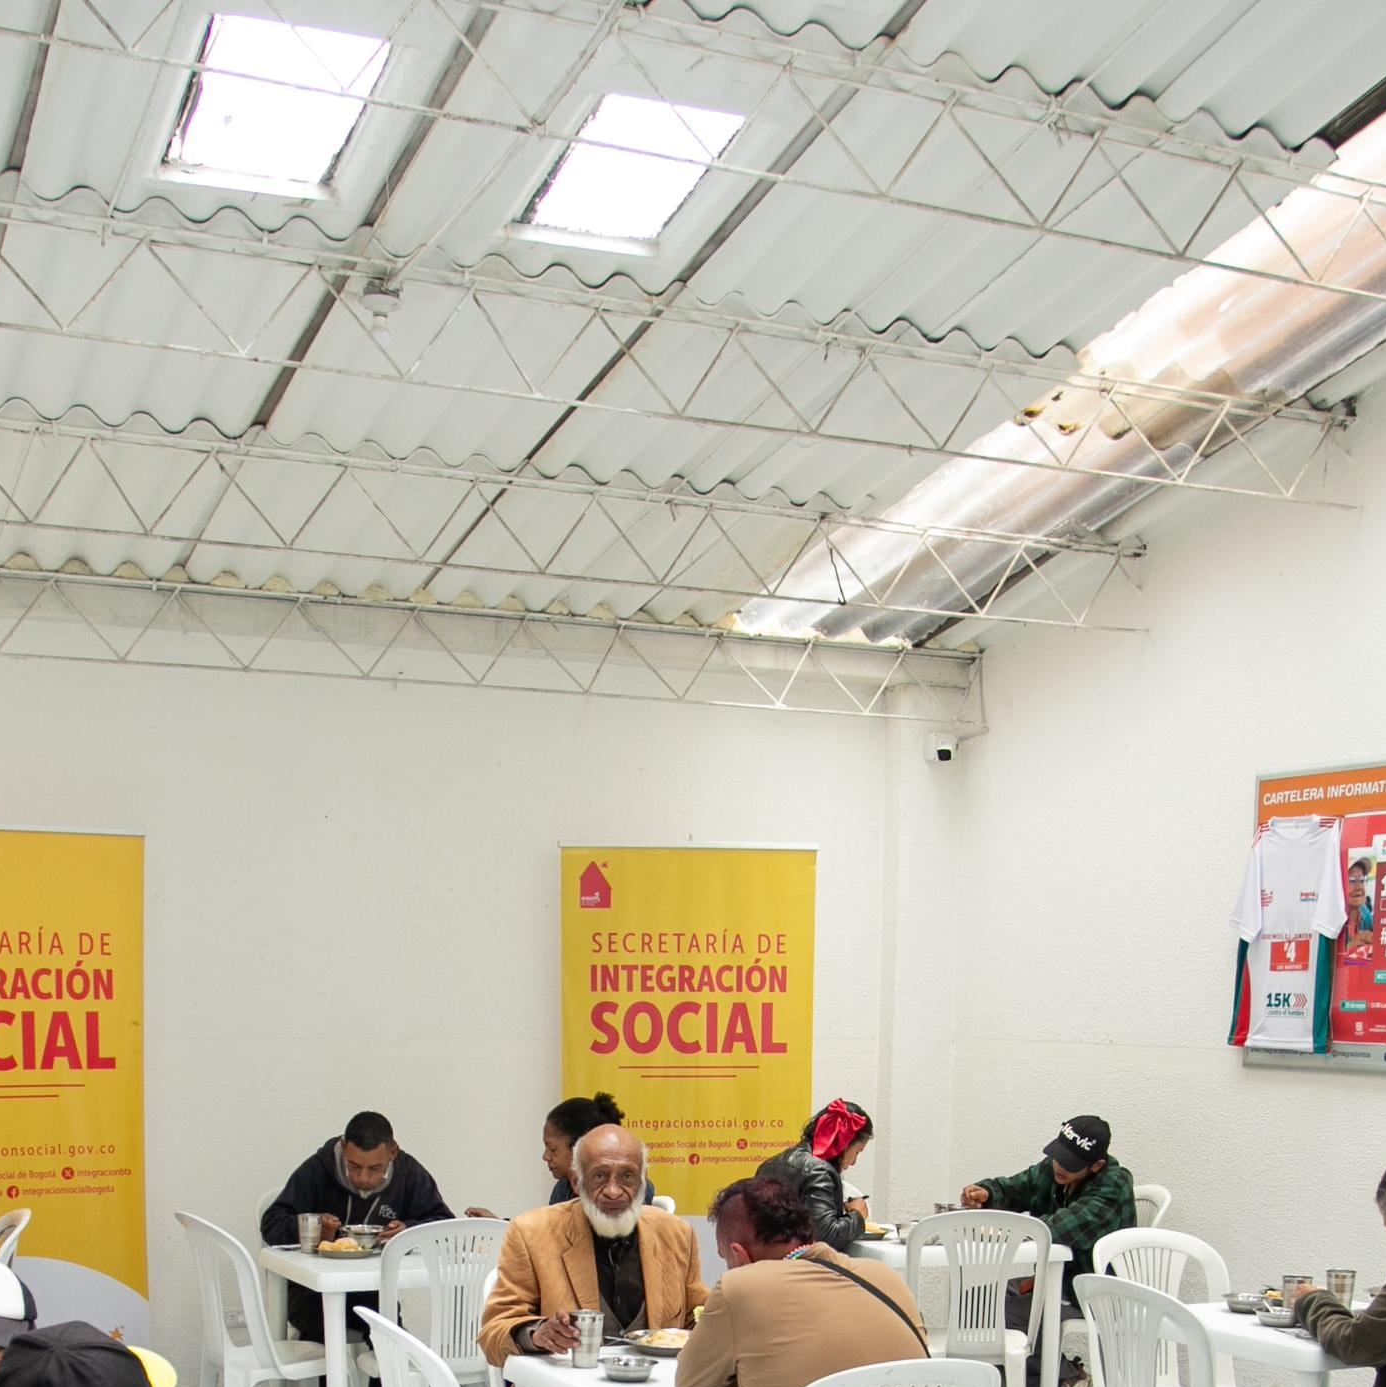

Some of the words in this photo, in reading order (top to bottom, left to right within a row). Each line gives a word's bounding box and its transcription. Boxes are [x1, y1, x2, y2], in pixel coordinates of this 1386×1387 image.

[1263, 786, 1325, 805] CARTELERA
[78, 932, 113, 956] DE
[591, 928, 745, 954] SECRETARÍA
[757, 933, 787, 954] DE
[590, 957, 788, 993] INTEGRACIÓN
[1266, 992, 1292, 1008] 15K
[589, 1000, 788, 1055] SOCIAL
[676, 1140, 697, 1149] Social
[698, 1140, 707, 1149] de
[708, 1140, 732, 1150] Bogotá
[16, 1170, 26, 1180] de
[28, 1169, 56, 1182] Bogotá
